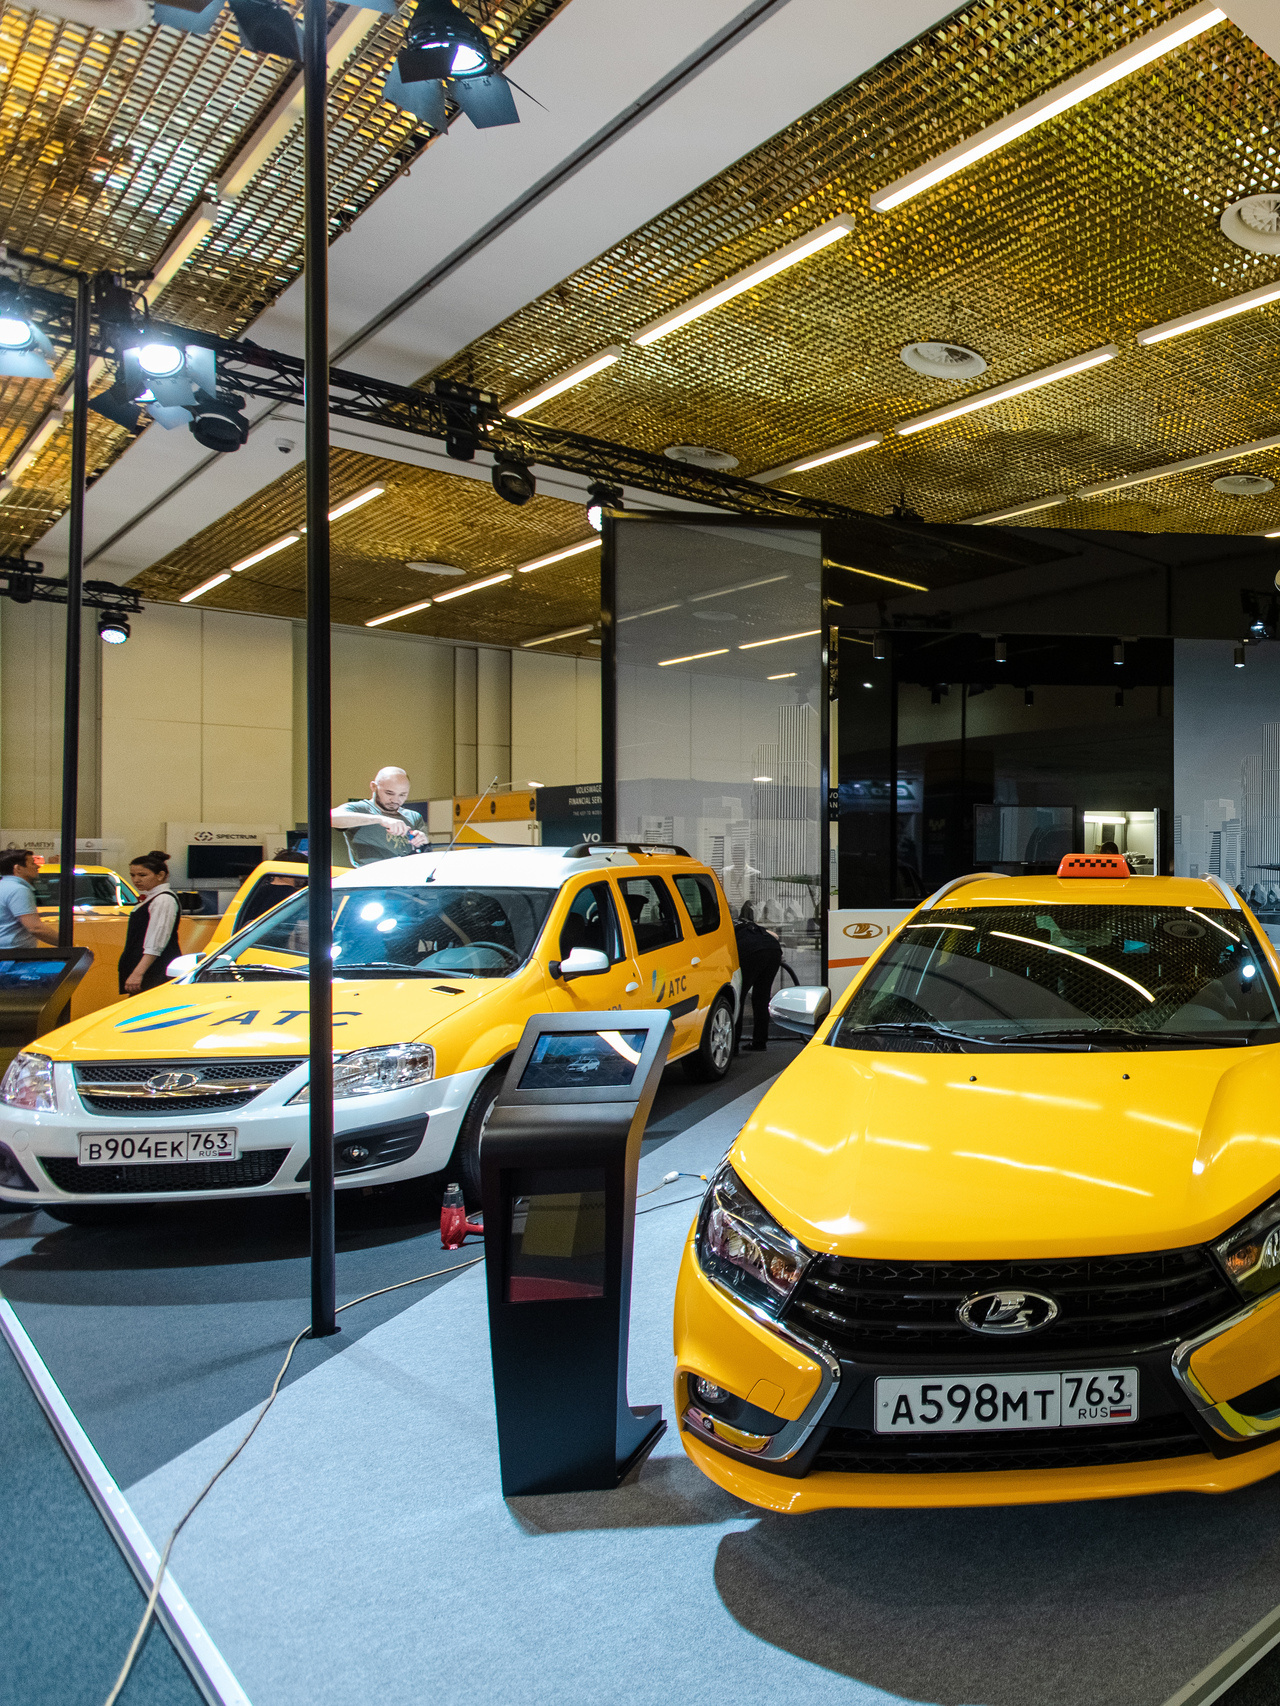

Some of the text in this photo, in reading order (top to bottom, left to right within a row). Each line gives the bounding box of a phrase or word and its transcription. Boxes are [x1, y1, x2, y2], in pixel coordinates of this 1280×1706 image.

[575, 785, 602, 794] VOLKSWAGE
[591, 796, 602, 804] SERV
[190, 1133, 228, 1151] 763
[1065, 1375, 1125, 1408] 763
[1078, 1407, 1108, 1420] RUS
